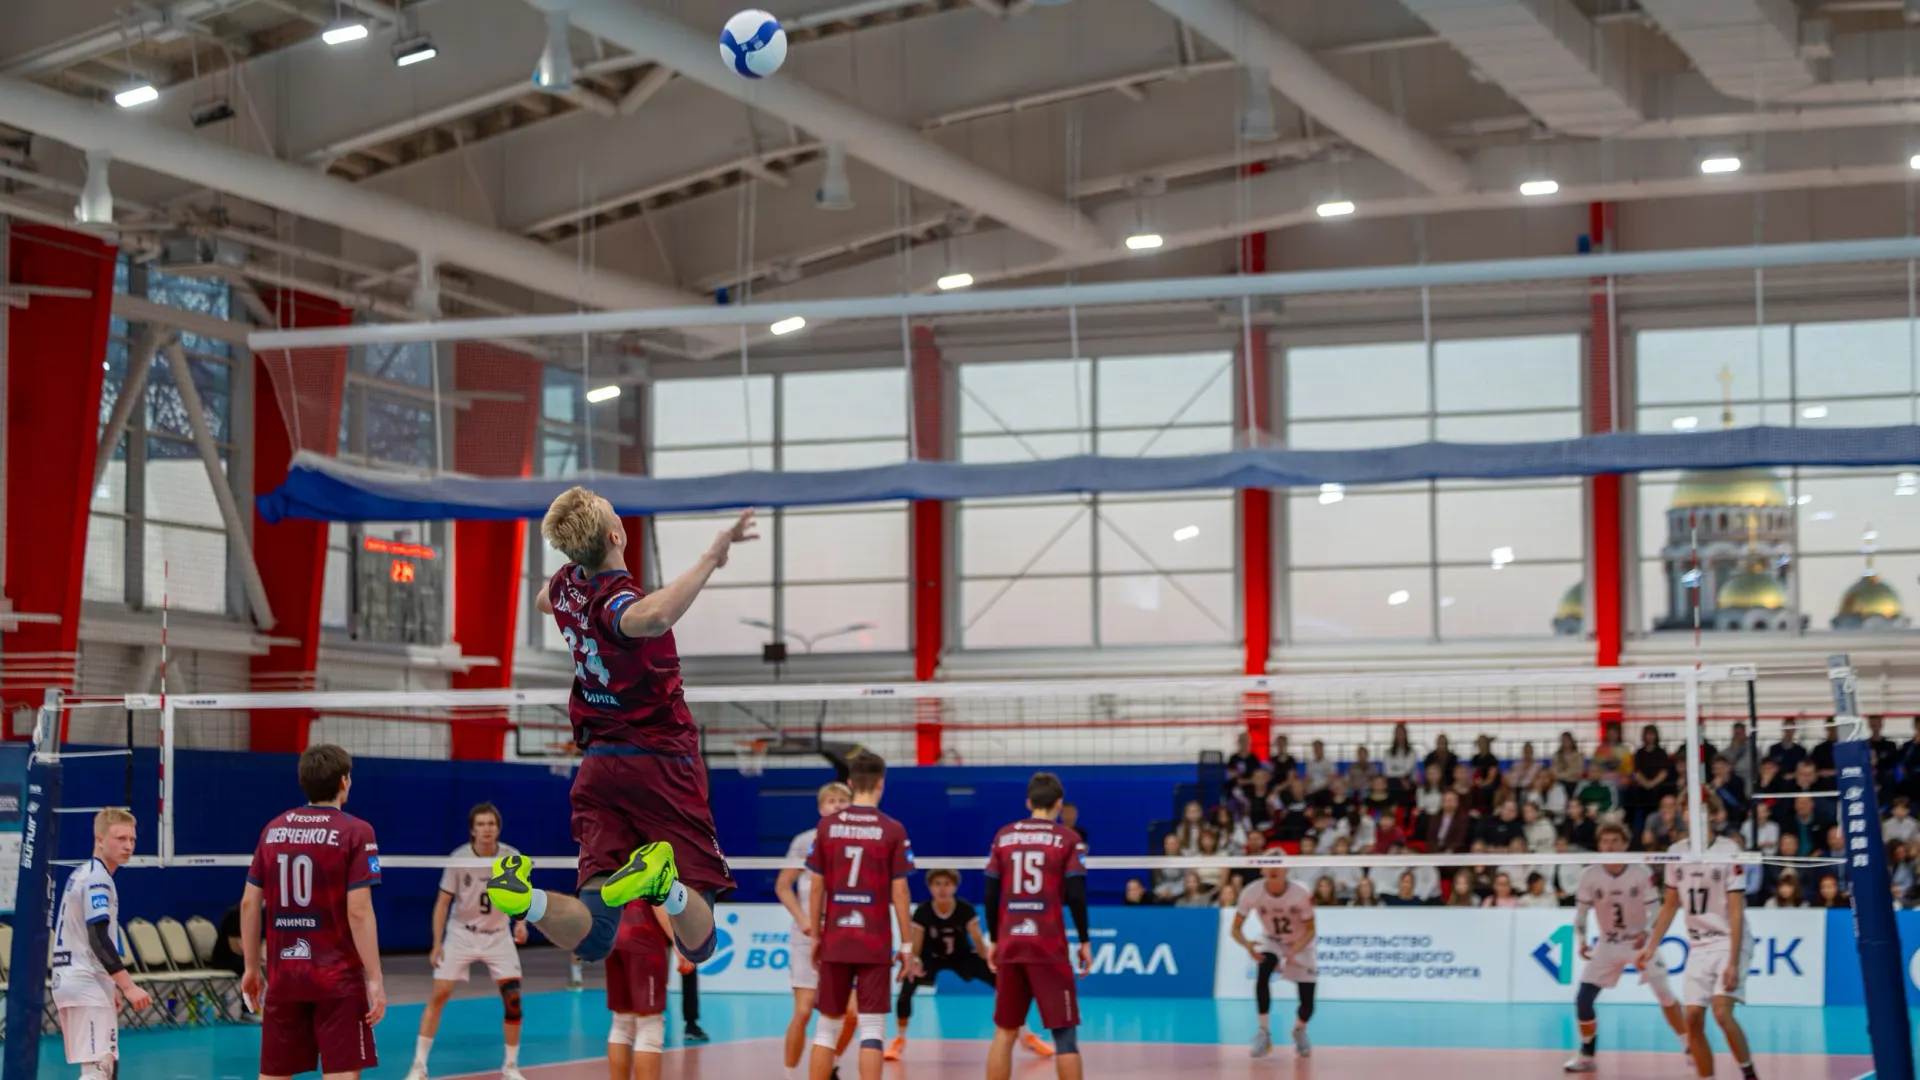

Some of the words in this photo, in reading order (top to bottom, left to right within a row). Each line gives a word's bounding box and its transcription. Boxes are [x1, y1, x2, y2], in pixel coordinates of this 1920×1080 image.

[266, 827, 326, 844] ШЕВЧЕНКО
[845, 846, 863, 887] 7
[1011, 851, 1044, 894] 15
[277, 853, 313, 907] 10
[480, 893, 491, 914] 9
[1688, 887, 1709, 915] 17
[1272, 916, 1293, 935] 12
[1316, 935, 1432, 948] РАВИТЕЛЬСТВО
[746, 948, 789, 969] ВО
